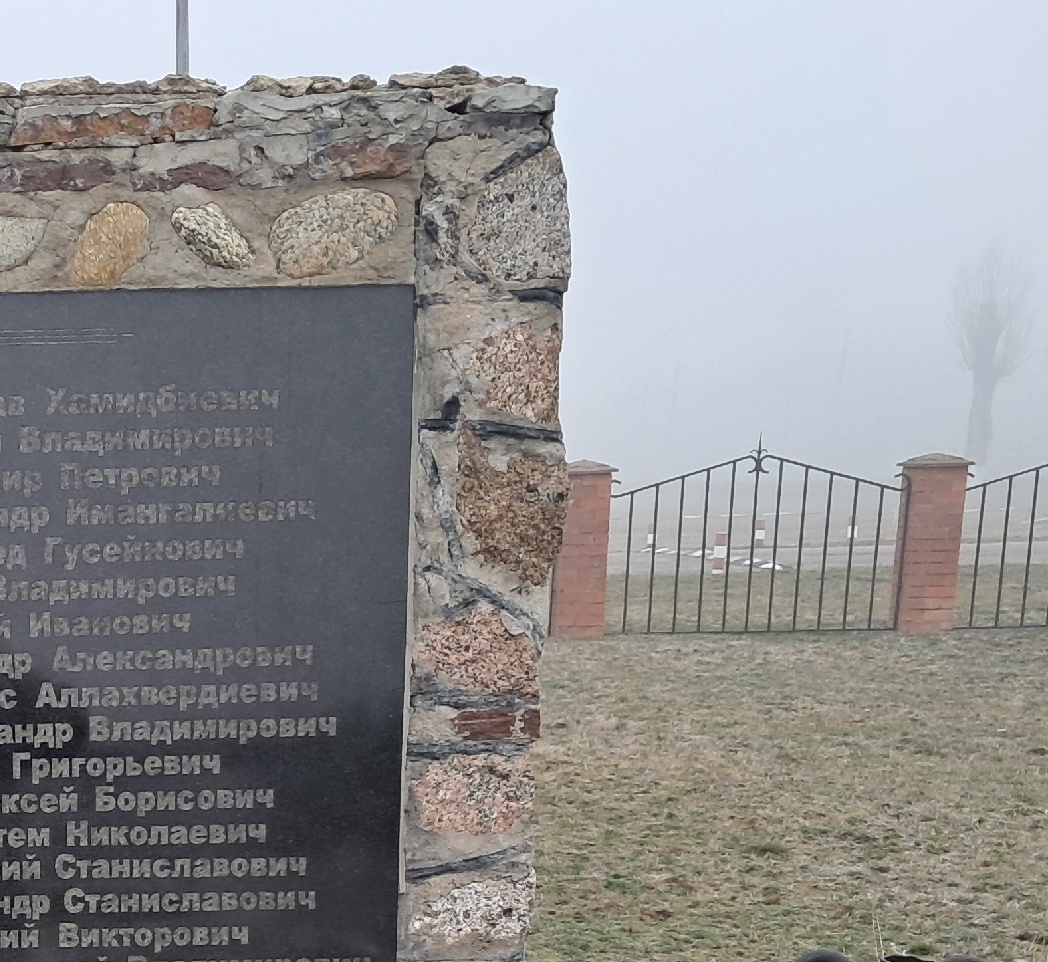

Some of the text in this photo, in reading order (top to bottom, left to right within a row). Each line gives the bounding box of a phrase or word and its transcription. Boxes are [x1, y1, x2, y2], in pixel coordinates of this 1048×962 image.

[19, 423, 276, 460] Владимирович
[59, 462, 221, 495] Петрович
[44, 534, 244, 570] Гусейнович
[29, 611, 191, 638] Иванович
[53, 643, 314, 676] Александрович
[36, 679, 319, 711] Аллахвердиевич
[89, 714, 337, 746] Владимирович
[12, 751, 221, 784] Григорьевич
[95, 784, 275, 815] Борисович
[65, 819, 267, 847] Николаевич
[55, 854, 307, 878] Станиславович
[63, 886, 316, 914] Станиславович
[58, 922, 249, 952] Викторович
